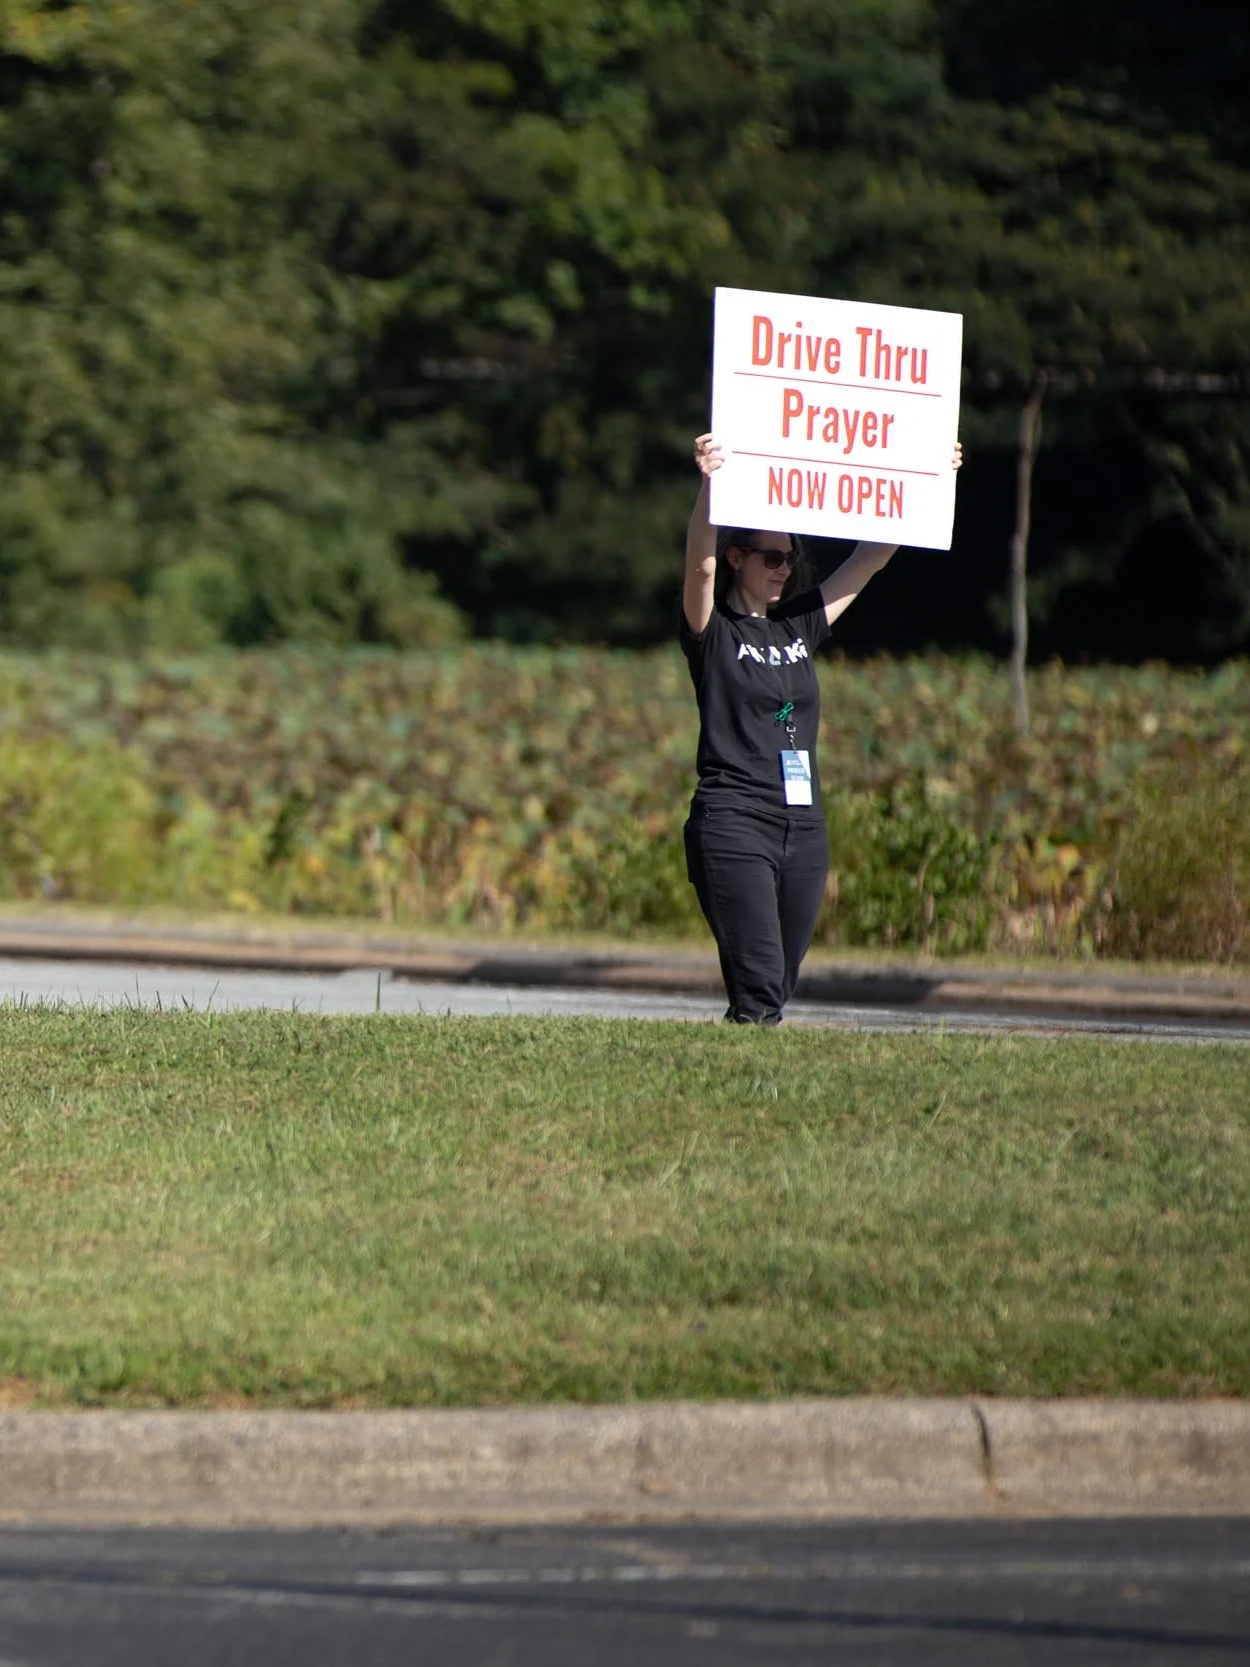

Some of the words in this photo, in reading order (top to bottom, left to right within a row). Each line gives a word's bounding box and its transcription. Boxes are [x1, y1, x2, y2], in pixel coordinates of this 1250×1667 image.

[751, 315, 842, 375] Drive
[855, 326, 928, 385] Thru
[781, 387, 896, 455] Prayer
[767, 466, 827, 511] NOW
[837, 474, 904, 519] OPEN
